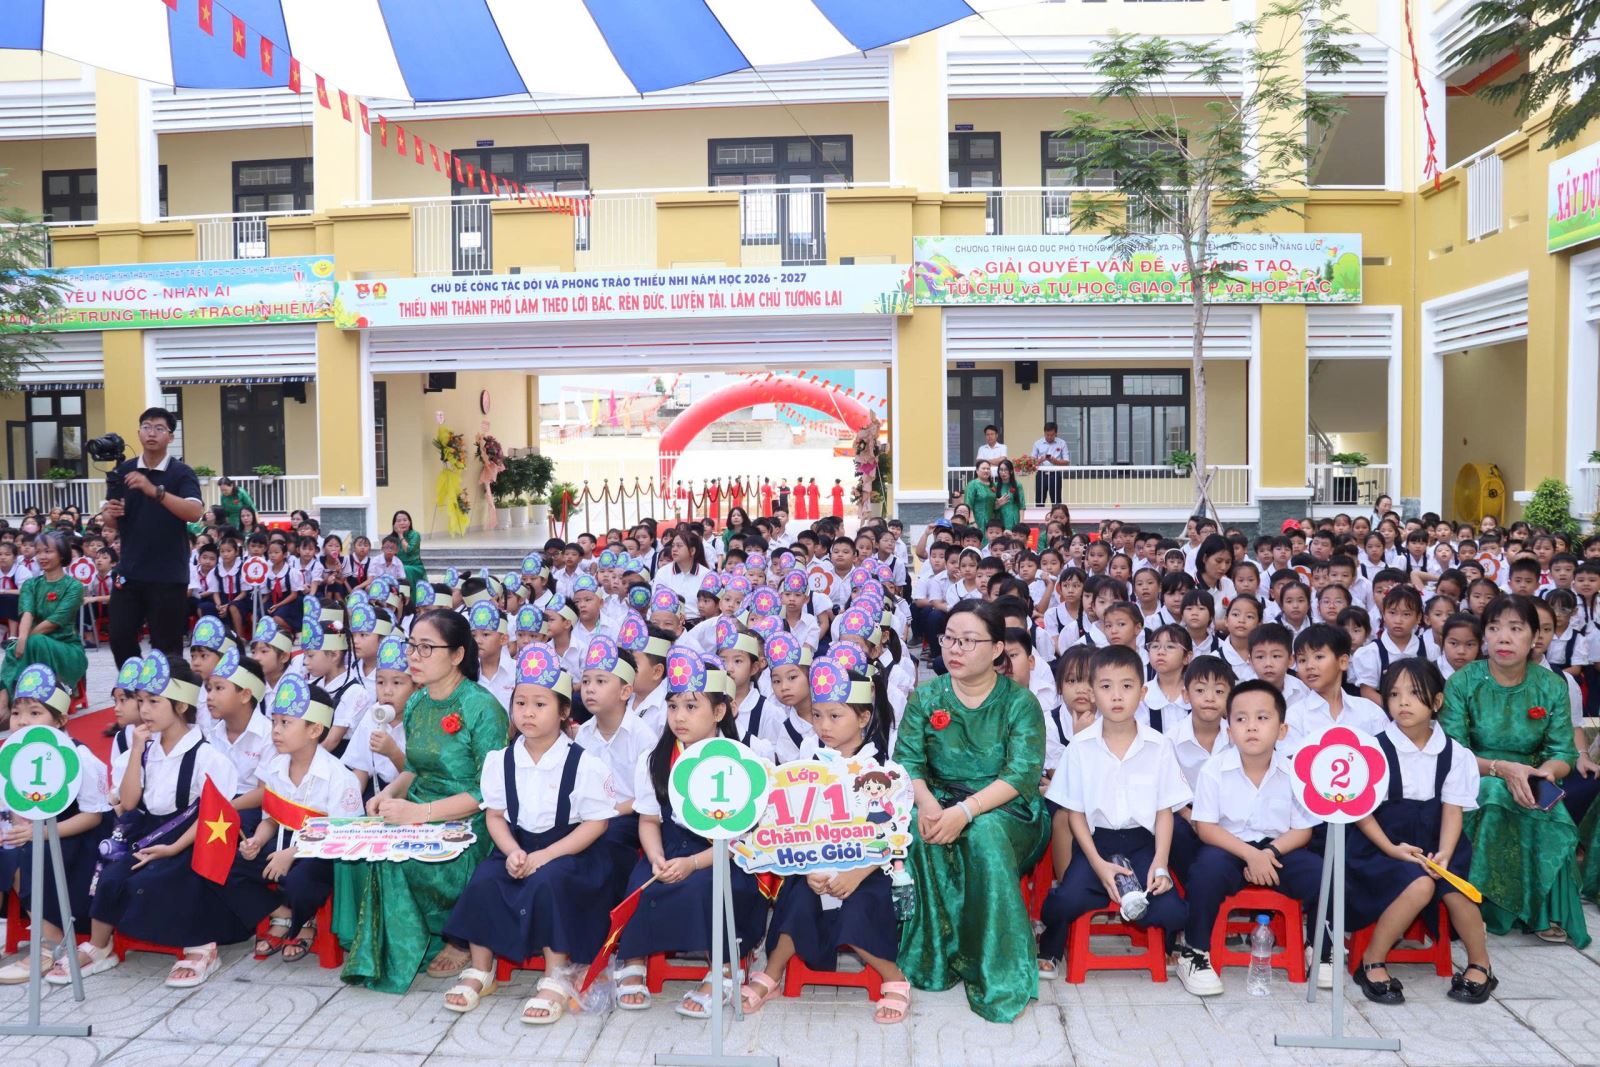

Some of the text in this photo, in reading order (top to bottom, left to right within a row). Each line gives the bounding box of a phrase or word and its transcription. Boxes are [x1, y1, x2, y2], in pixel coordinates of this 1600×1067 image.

[1557, 158, 1600, 222] XÂY DỰ
[985, 257, 1022, 274] GIẢI
[1028, 256, 1090, 274] QUYẾT
[1096, 256, 1134, 273] VẤN
[1141, 256, 1165, 272] ĐỀ
[65, 289, 97, 303] YÊU
[102, 287, 148, 301] NƯỚC
[163, 284, 209, 299] NHÂN
[431, 281, 451, 293] CHỦ
[454, 280, 468, 292] ĐỀ
[470, 280, 499, 292] CÔNG
[502, 279, 520, 291] TÁC
[523, 278, 542, 292] ĐỘI
[545, 277, 559, 289] VÀ
[561, 278, 599, 289] PHONG
[602, 275, 631, 287] TRÀO
[633, 273, 666, 287] THIẾU
[668, 276, 688, 286] NHI
[691, 274, 716, 285] NĂM
[719, 274, 742, 287] HỌC
[744, 274, 771, 284] 2026
[780, 273, 807, 283] 2027
[947, 281, 970, 297] TỰ
[976, 279, 1014, 295] CHỦ
[1021, 281, 1040, 294] và
[1048, 281, 1071, 296] TỰ
[1129, 281, 1173, 294] GIAO
[1251, 280, 1289, 296] HỢP
[1295, 278, 1331, 293] TÁC
[79, 310, 133, 322] TRUNG
[139, 307, 183, 321] THỰC
[199, 303, 255, 318] TRÁCH
[261, 300, 314, 317] NHIỆM
[399, 297, 427, 317] THIẾU
[430, 301, 448, 316] NHI
[452, 297, 487, 316] THÀNH
[490, 294, 512, 315] PHỐ
[515, 295, 539, 314] LÀM
[542, 297, 568, 313] THEO
[572, 293, 588, 312] LỜI
[619, 292, 640, 311] RÈN
[671, 290, 705, 312] LUYỆN
[730, 289, 755, 308] LÀM
[759, 287, 781, 307] CHỦ
[785, 289, 821, 306] TƯƠNG
[825, 290, 842, 306] LAI
[786, 768, 820, 783] Lớp
[768, 784, 850, 826] 1/1
[756, 824, 875, 846] Chăm Ngoan
[323, 840, 441, 855] Lớp 1/2
[776, 842, 861, 867] Học Giỏi
